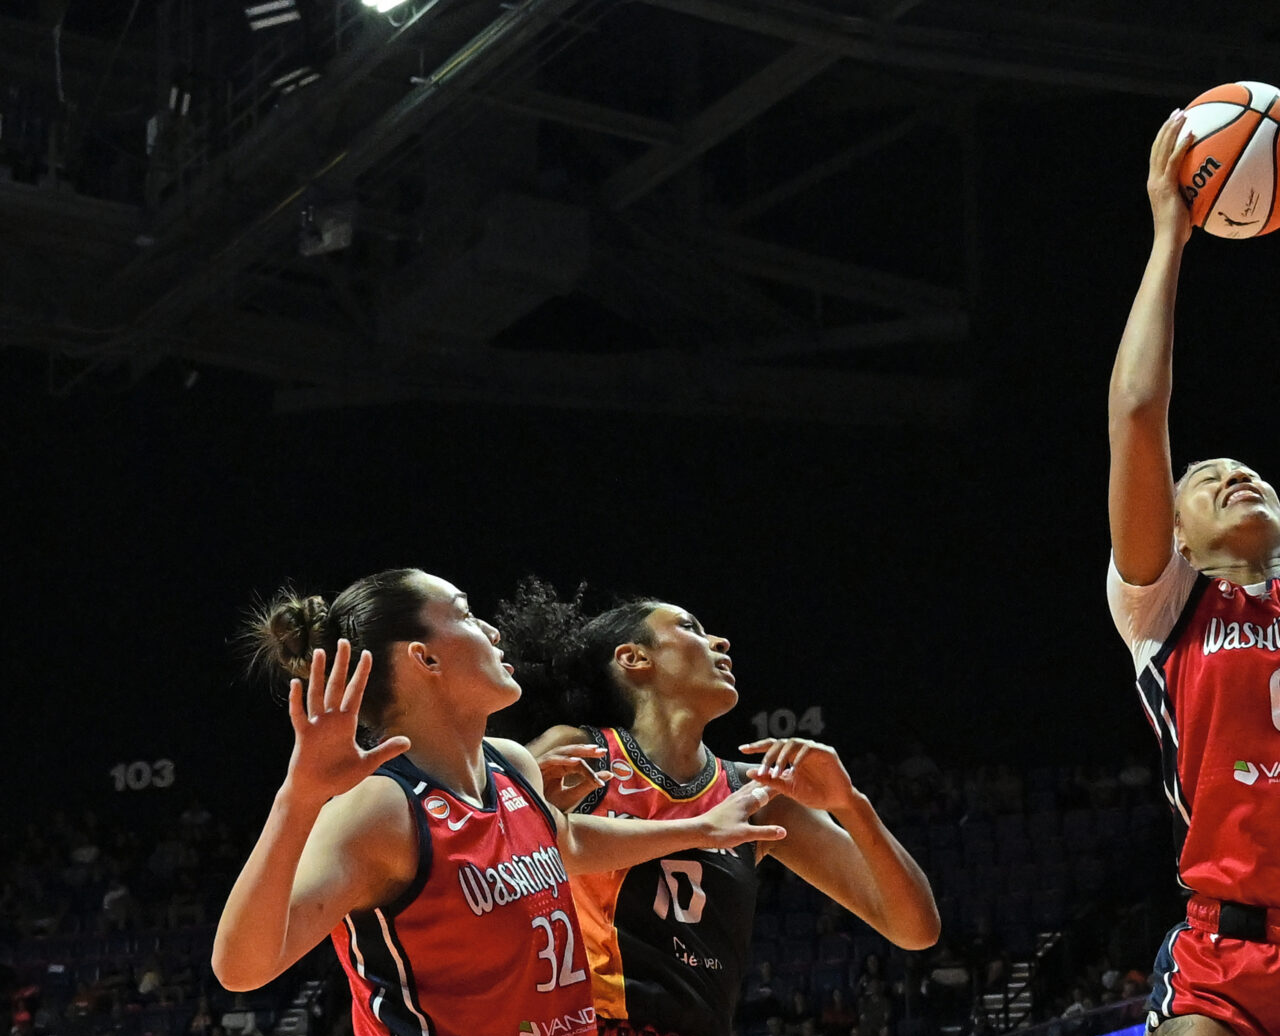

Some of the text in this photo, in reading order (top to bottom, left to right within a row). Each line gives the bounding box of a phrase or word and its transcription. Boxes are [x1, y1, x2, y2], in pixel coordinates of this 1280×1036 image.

[751, 705, 825, 739] 104
[110, 758, 175, 791] 103
[532, 909, 586, 993] 32
[541, 1006, 597, 1036] VAND
